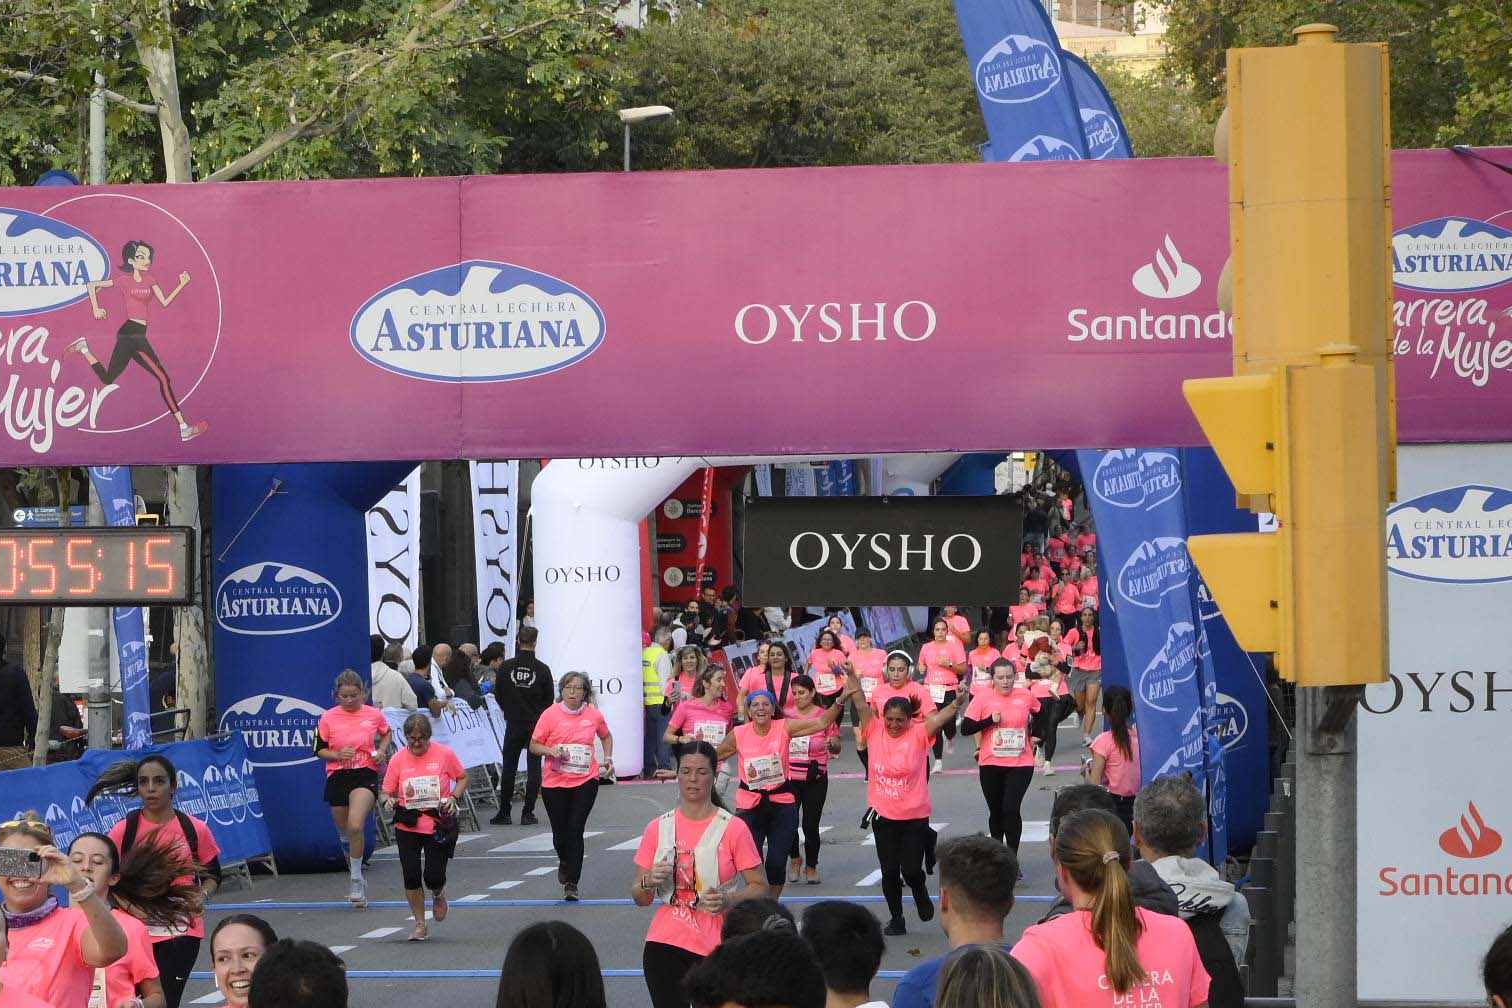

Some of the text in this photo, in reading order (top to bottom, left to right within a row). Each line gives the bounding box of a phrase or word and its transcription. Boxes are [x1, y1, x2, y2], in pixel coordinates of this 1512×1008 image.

[14, 243, 85, 255] LECHERA
[409, 302, 577, 316] CENTRAL LECHERA
[370, 307, 586, 352] ASTURIANA
[734, 300, 937, 345] OYSHO
[1067, 308, 1233, 342] Santand
[1417, 321, 1512, 387] la Muje
[1414, 519, 1481, 530] CENTRAL
[790, 531, 982, 572] OYSHO
[545, 565, 621, 584] OYSHO
[232, 586, 328, 595] CENTRAL LECHERA
[220, 591, 333, 619] ASTURIANA
[516, 672, 530, 681] BP
[1114, 987, 1160, 1006] DE LA
